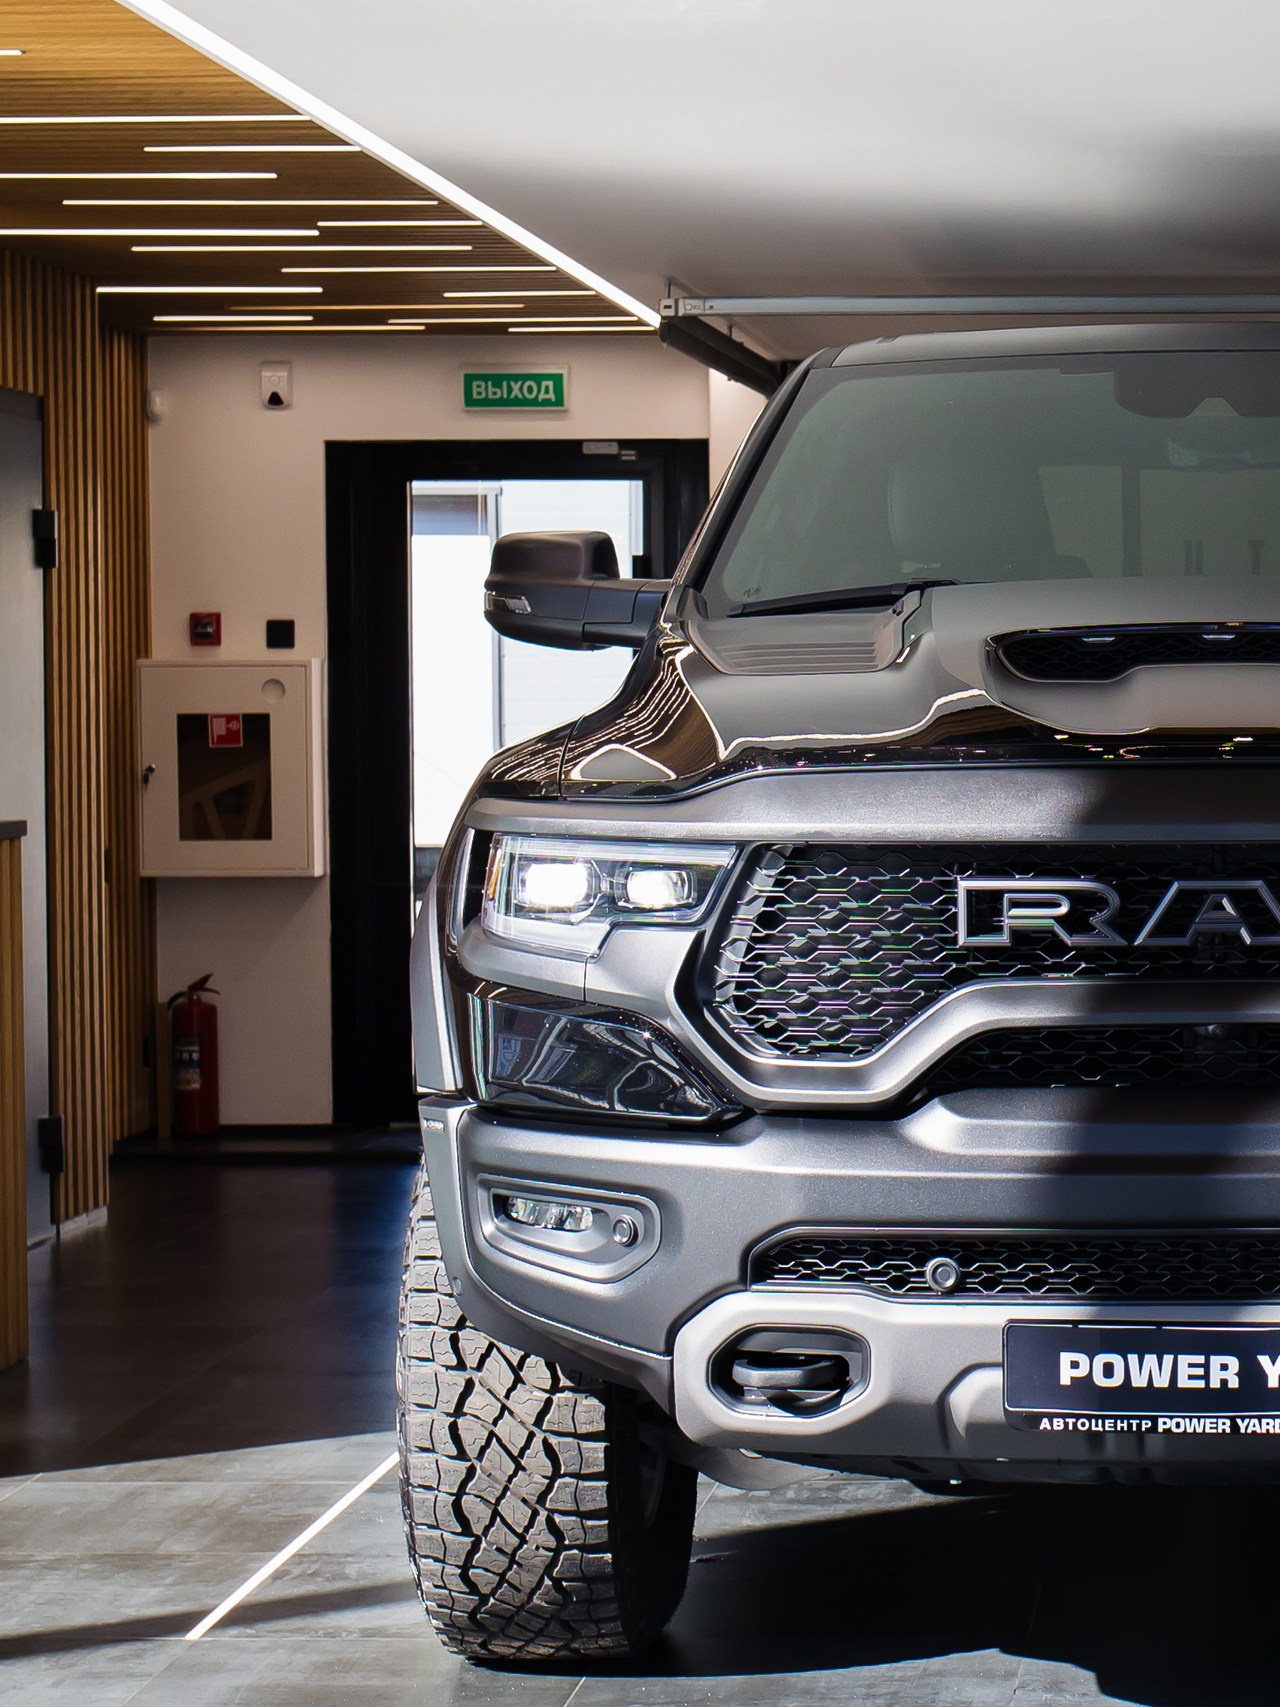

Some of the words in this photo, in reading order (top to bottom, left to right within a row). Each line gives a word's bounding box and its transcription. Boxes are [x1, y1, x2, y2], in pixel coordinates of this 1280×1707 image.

[472, 380, 556, 402] ВЫХОД
[1058, 1351, 1240, 1389] POWER
[1039, 1417, 1152, 1432] АВТОЦЕНТР
[1157, 1417, 1231, 1434] POWER
